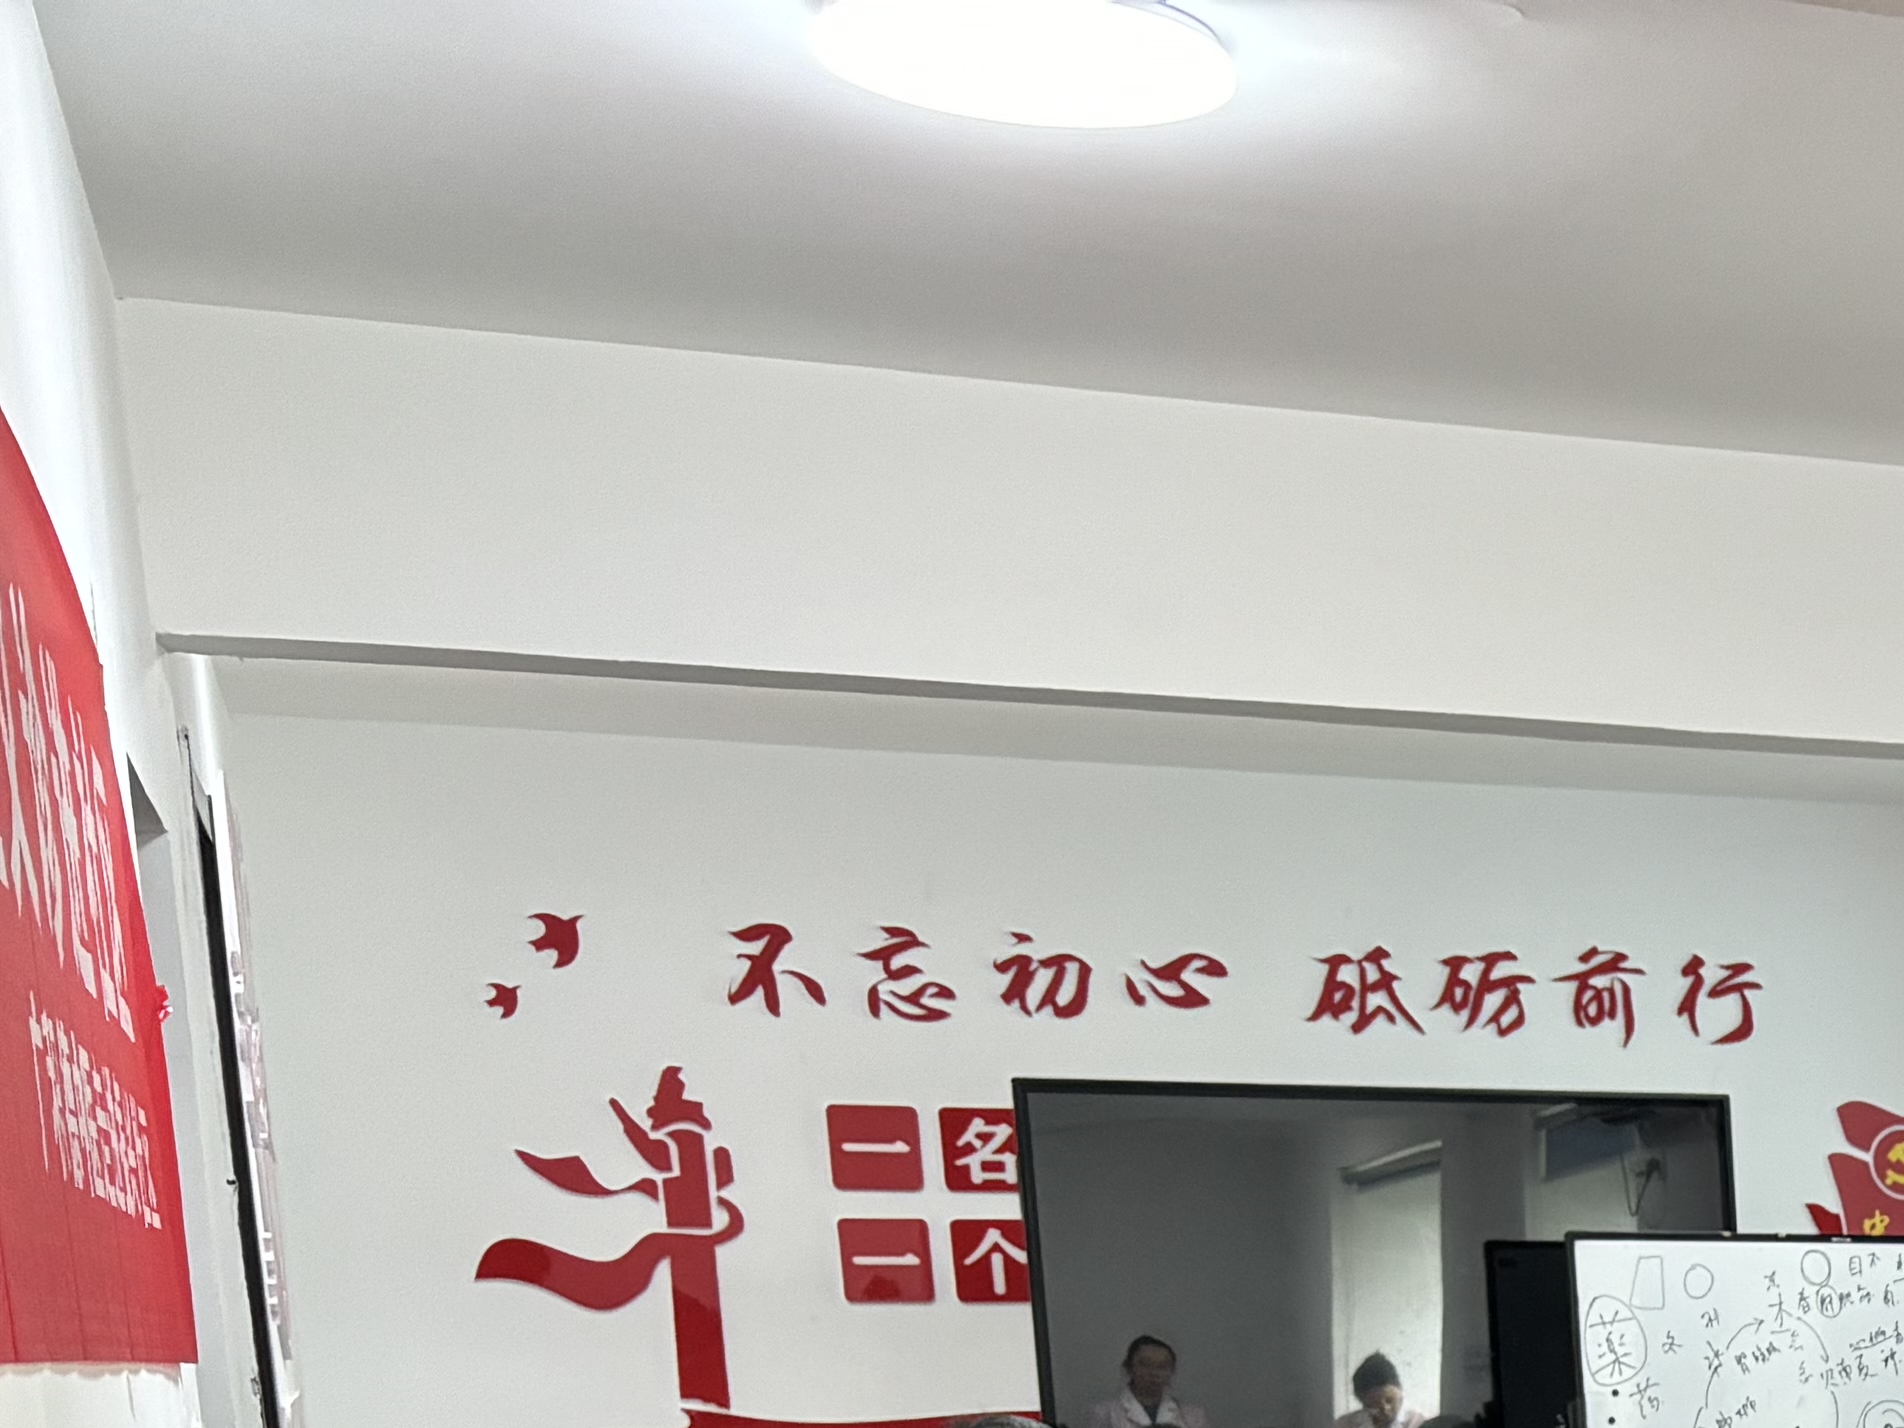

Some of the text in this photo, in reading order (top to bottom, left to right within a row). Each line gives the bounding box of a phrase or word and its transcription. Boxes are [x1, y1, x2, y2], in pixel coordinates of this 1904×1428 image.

[727, 923, 1764, 1048] 不忘初心 砥砺前行
